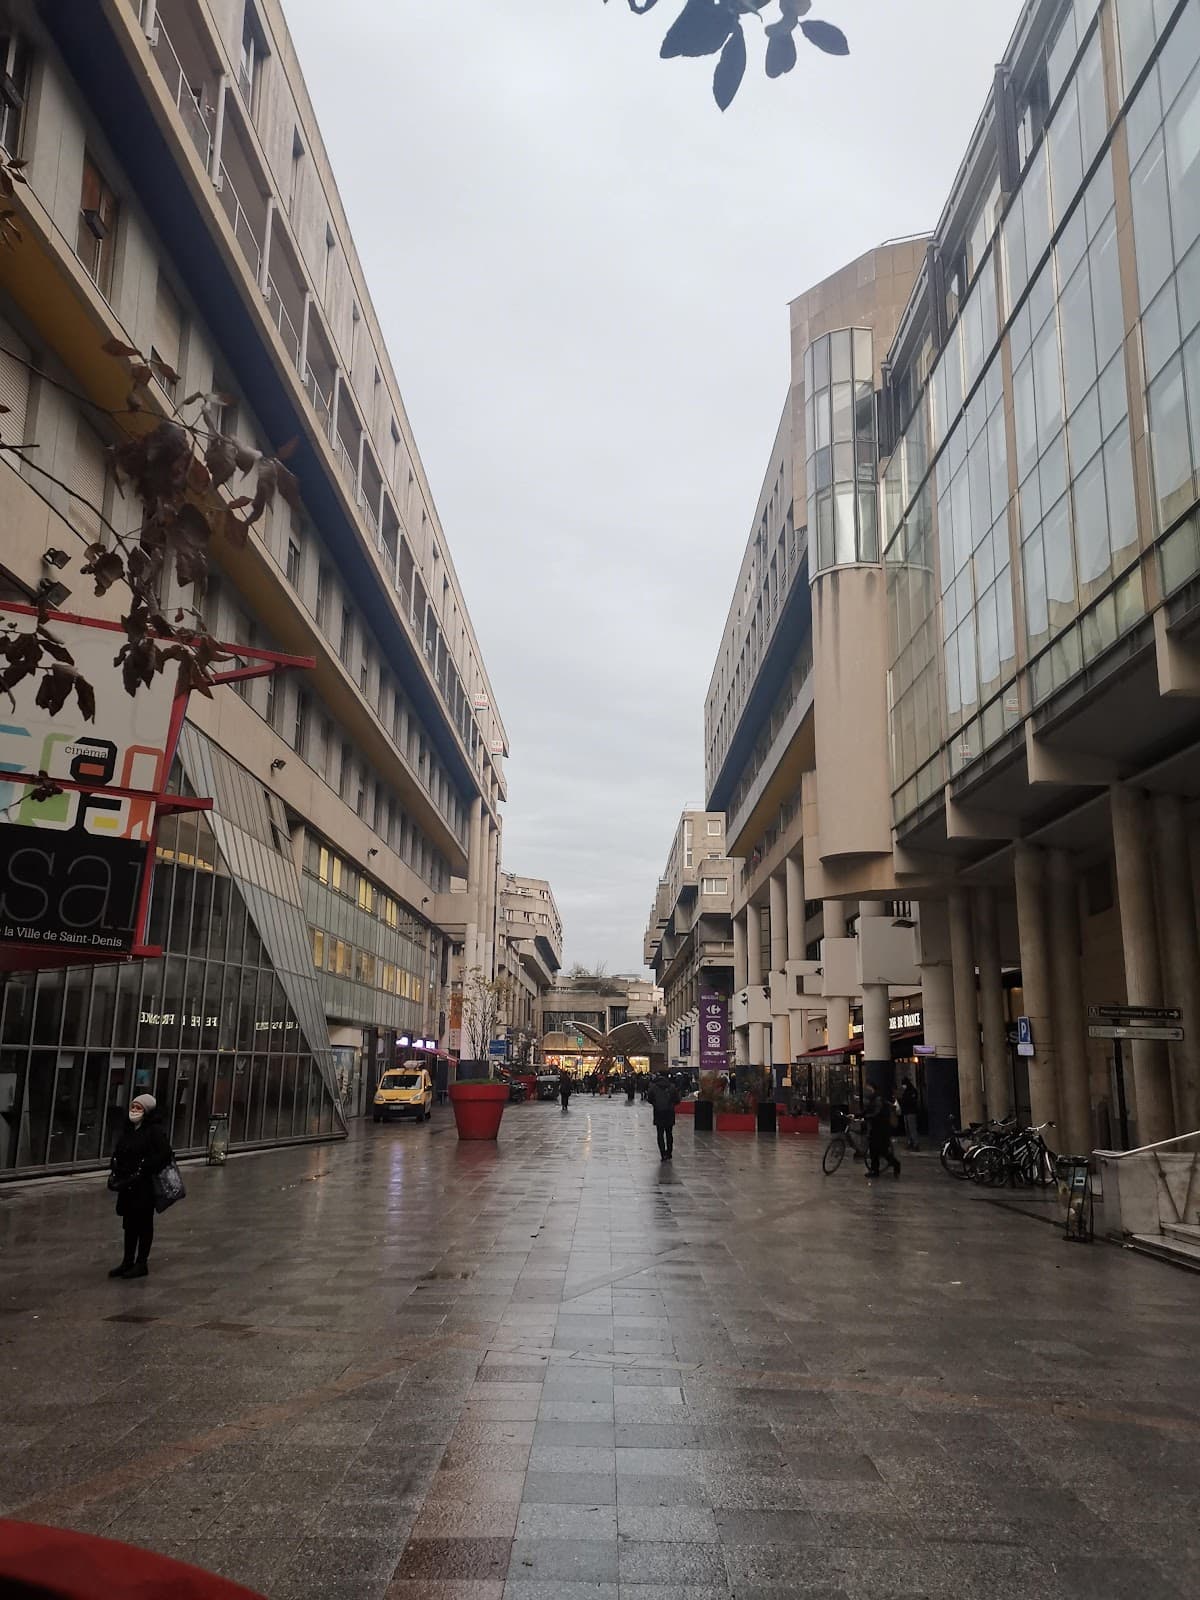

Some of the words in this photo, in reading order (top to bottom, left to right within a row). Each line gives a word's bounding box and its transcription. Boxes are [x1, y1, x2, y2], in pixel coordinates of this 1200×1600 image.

[4, 925, 14, 936] la
[16, 927, 41, 940] Ville
[42, 929, 57, 941] de
[59, 931, 122, 947] Saint-Denis
[903, 1013, 921, 1028] FRANCE
[1020, 1022, 1027, 1039] P
